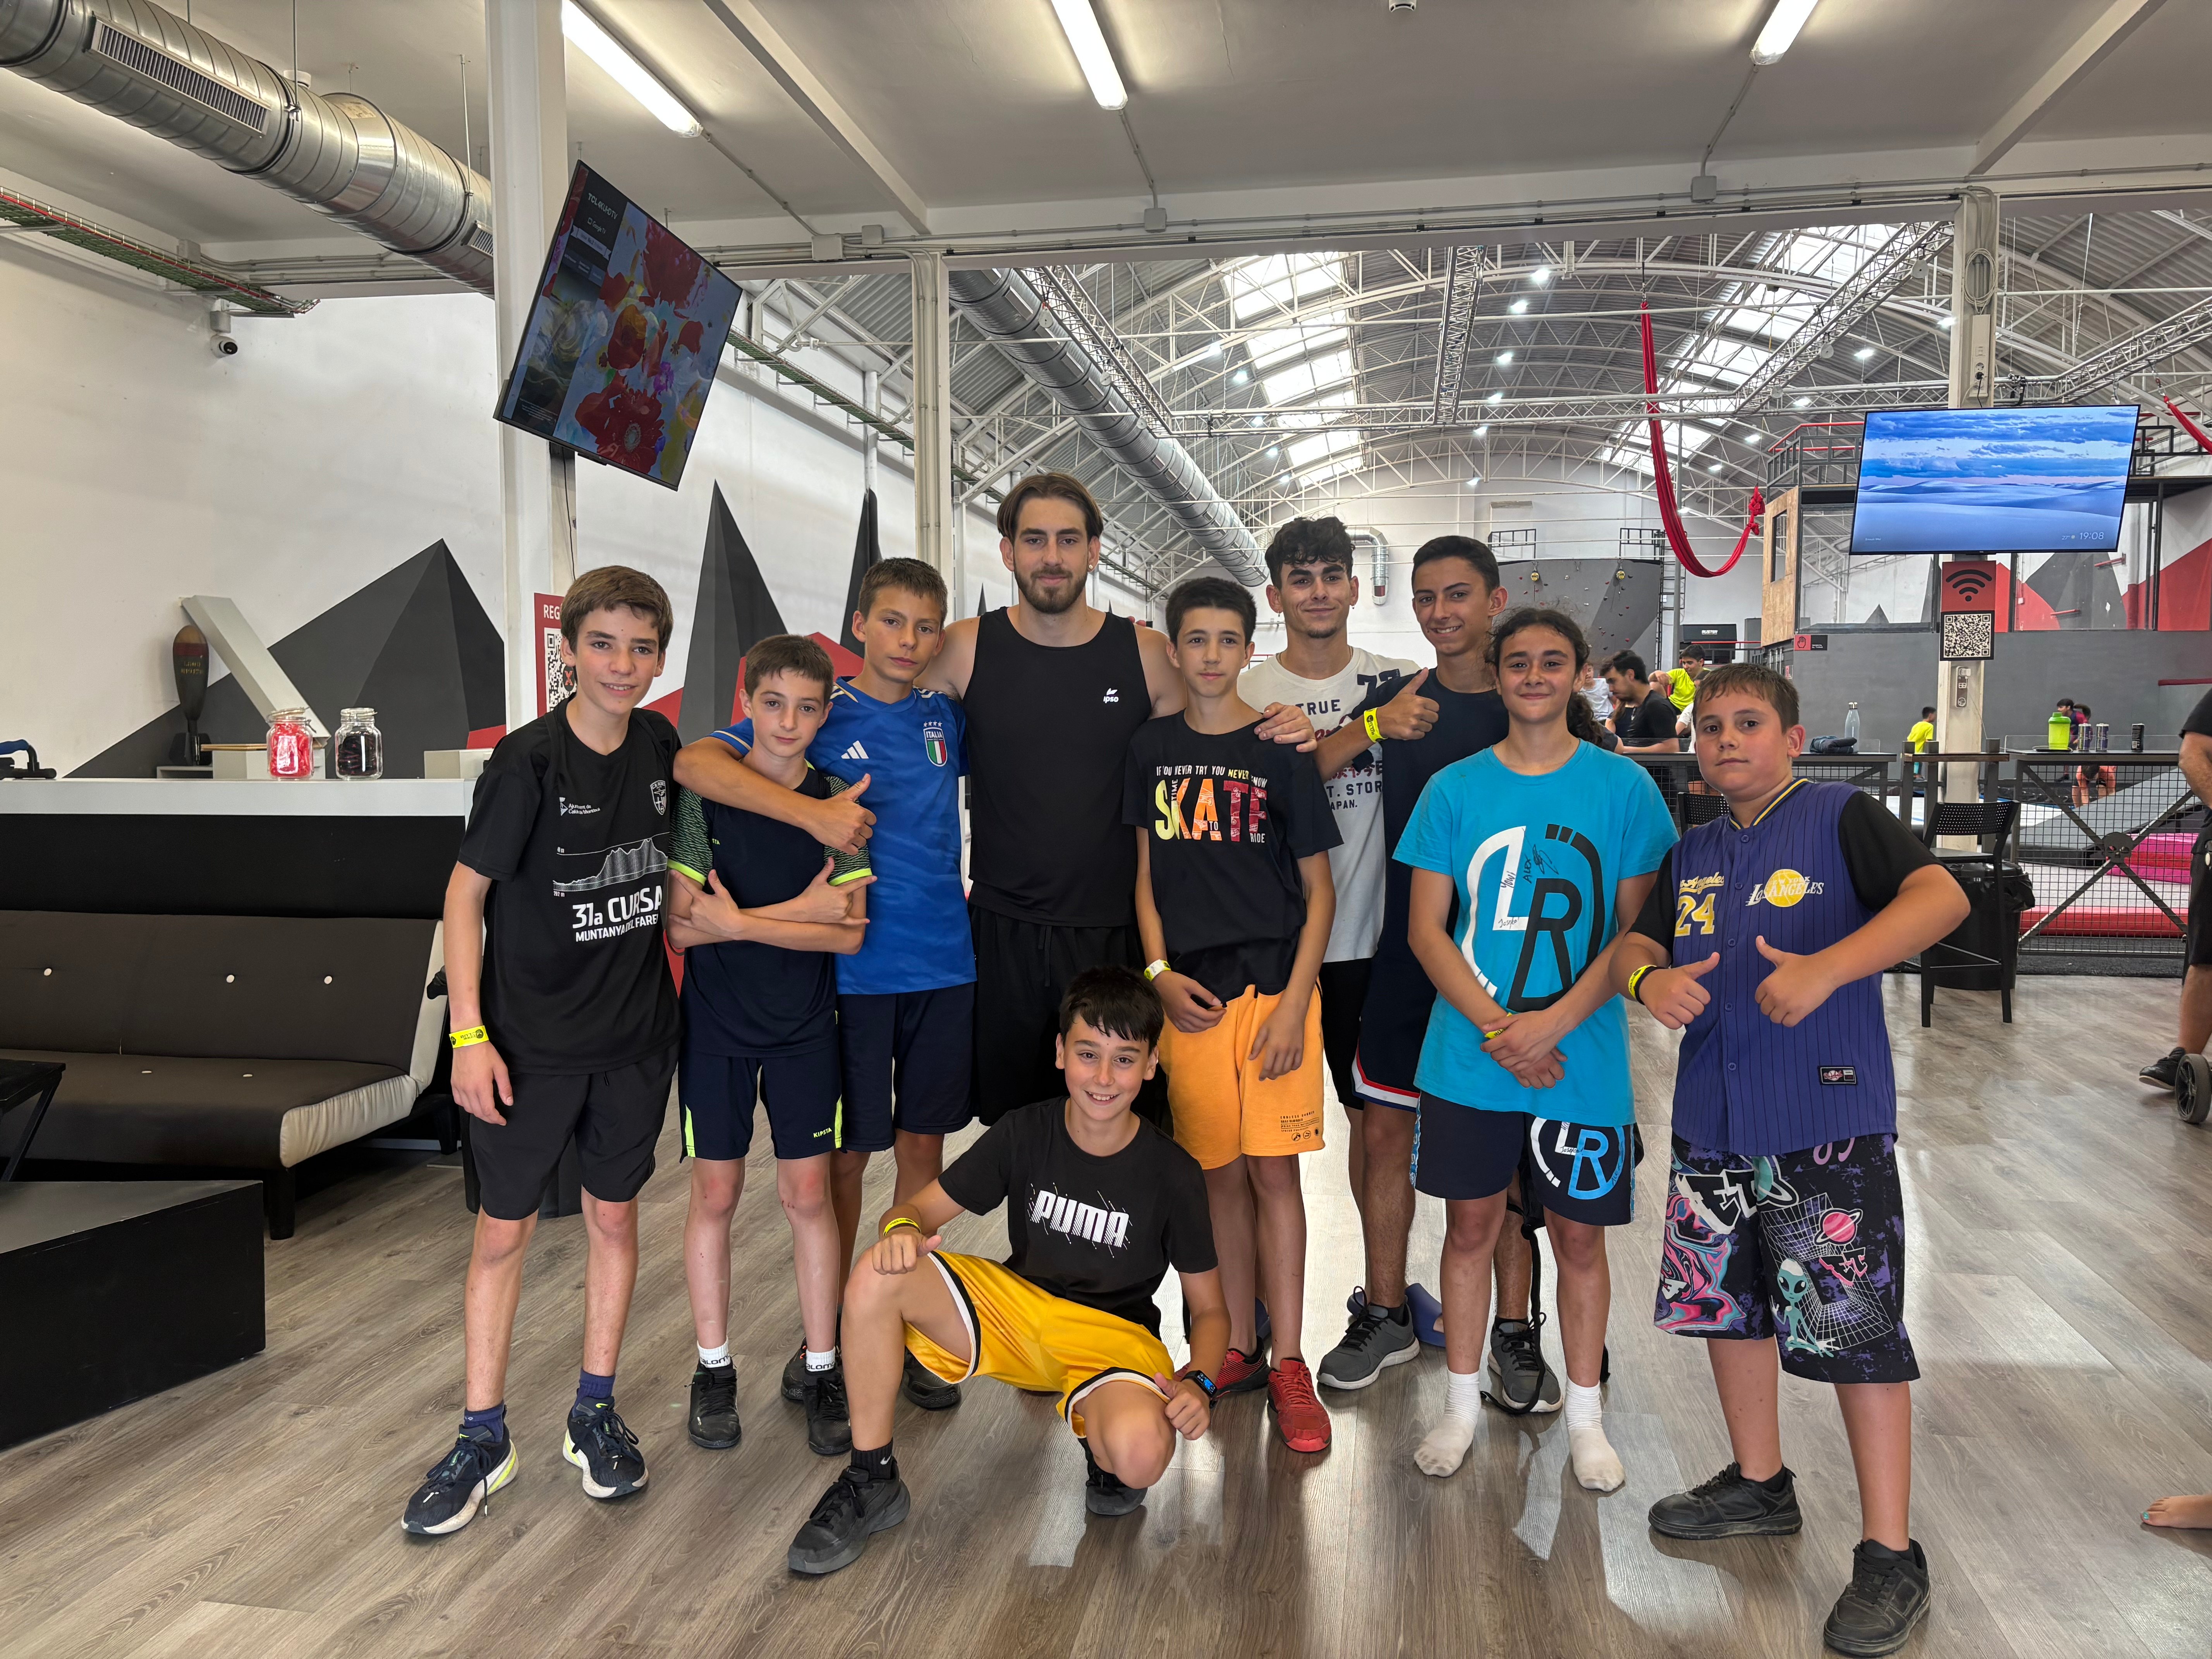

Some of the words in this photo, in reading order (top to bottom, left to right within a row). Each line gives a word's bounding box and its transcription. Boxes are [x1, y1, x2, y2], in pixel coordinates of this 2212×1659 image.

[2080, 532, 2104, 540] 19:08
[543, 604, 560, 620] REG
[1156, 766, 1161, 776] IF
[1162, 765, 1173, 776] OU
[1174, 765, 1192, 776] NEVER
[1195, 765, 1208, 775] TRY
[1212, 765, 1226, 776] YOU
[1228, 769, 1249, 780] NEVER
[1346, 780, 1382, 796] STOR
[1155, 777, 1267, 842] SKATE
[1330, 799, 1358, 811] APAN.
[1208, 821, 1219, 831] TO
[1249, 833, 1266, 843] RIDE
[572, 902, 603, 929] 31a
[608, 885, 663, 923] CURSA
[1674, 893, 1716, 937] 24
[575, 924, 625, 942] MUNTANYA
[624, 919, 635, 933] DEL
[813, 1127, 832, 1138] KIPSTA
[1030, 1190, 1130, 1248] PUMA
